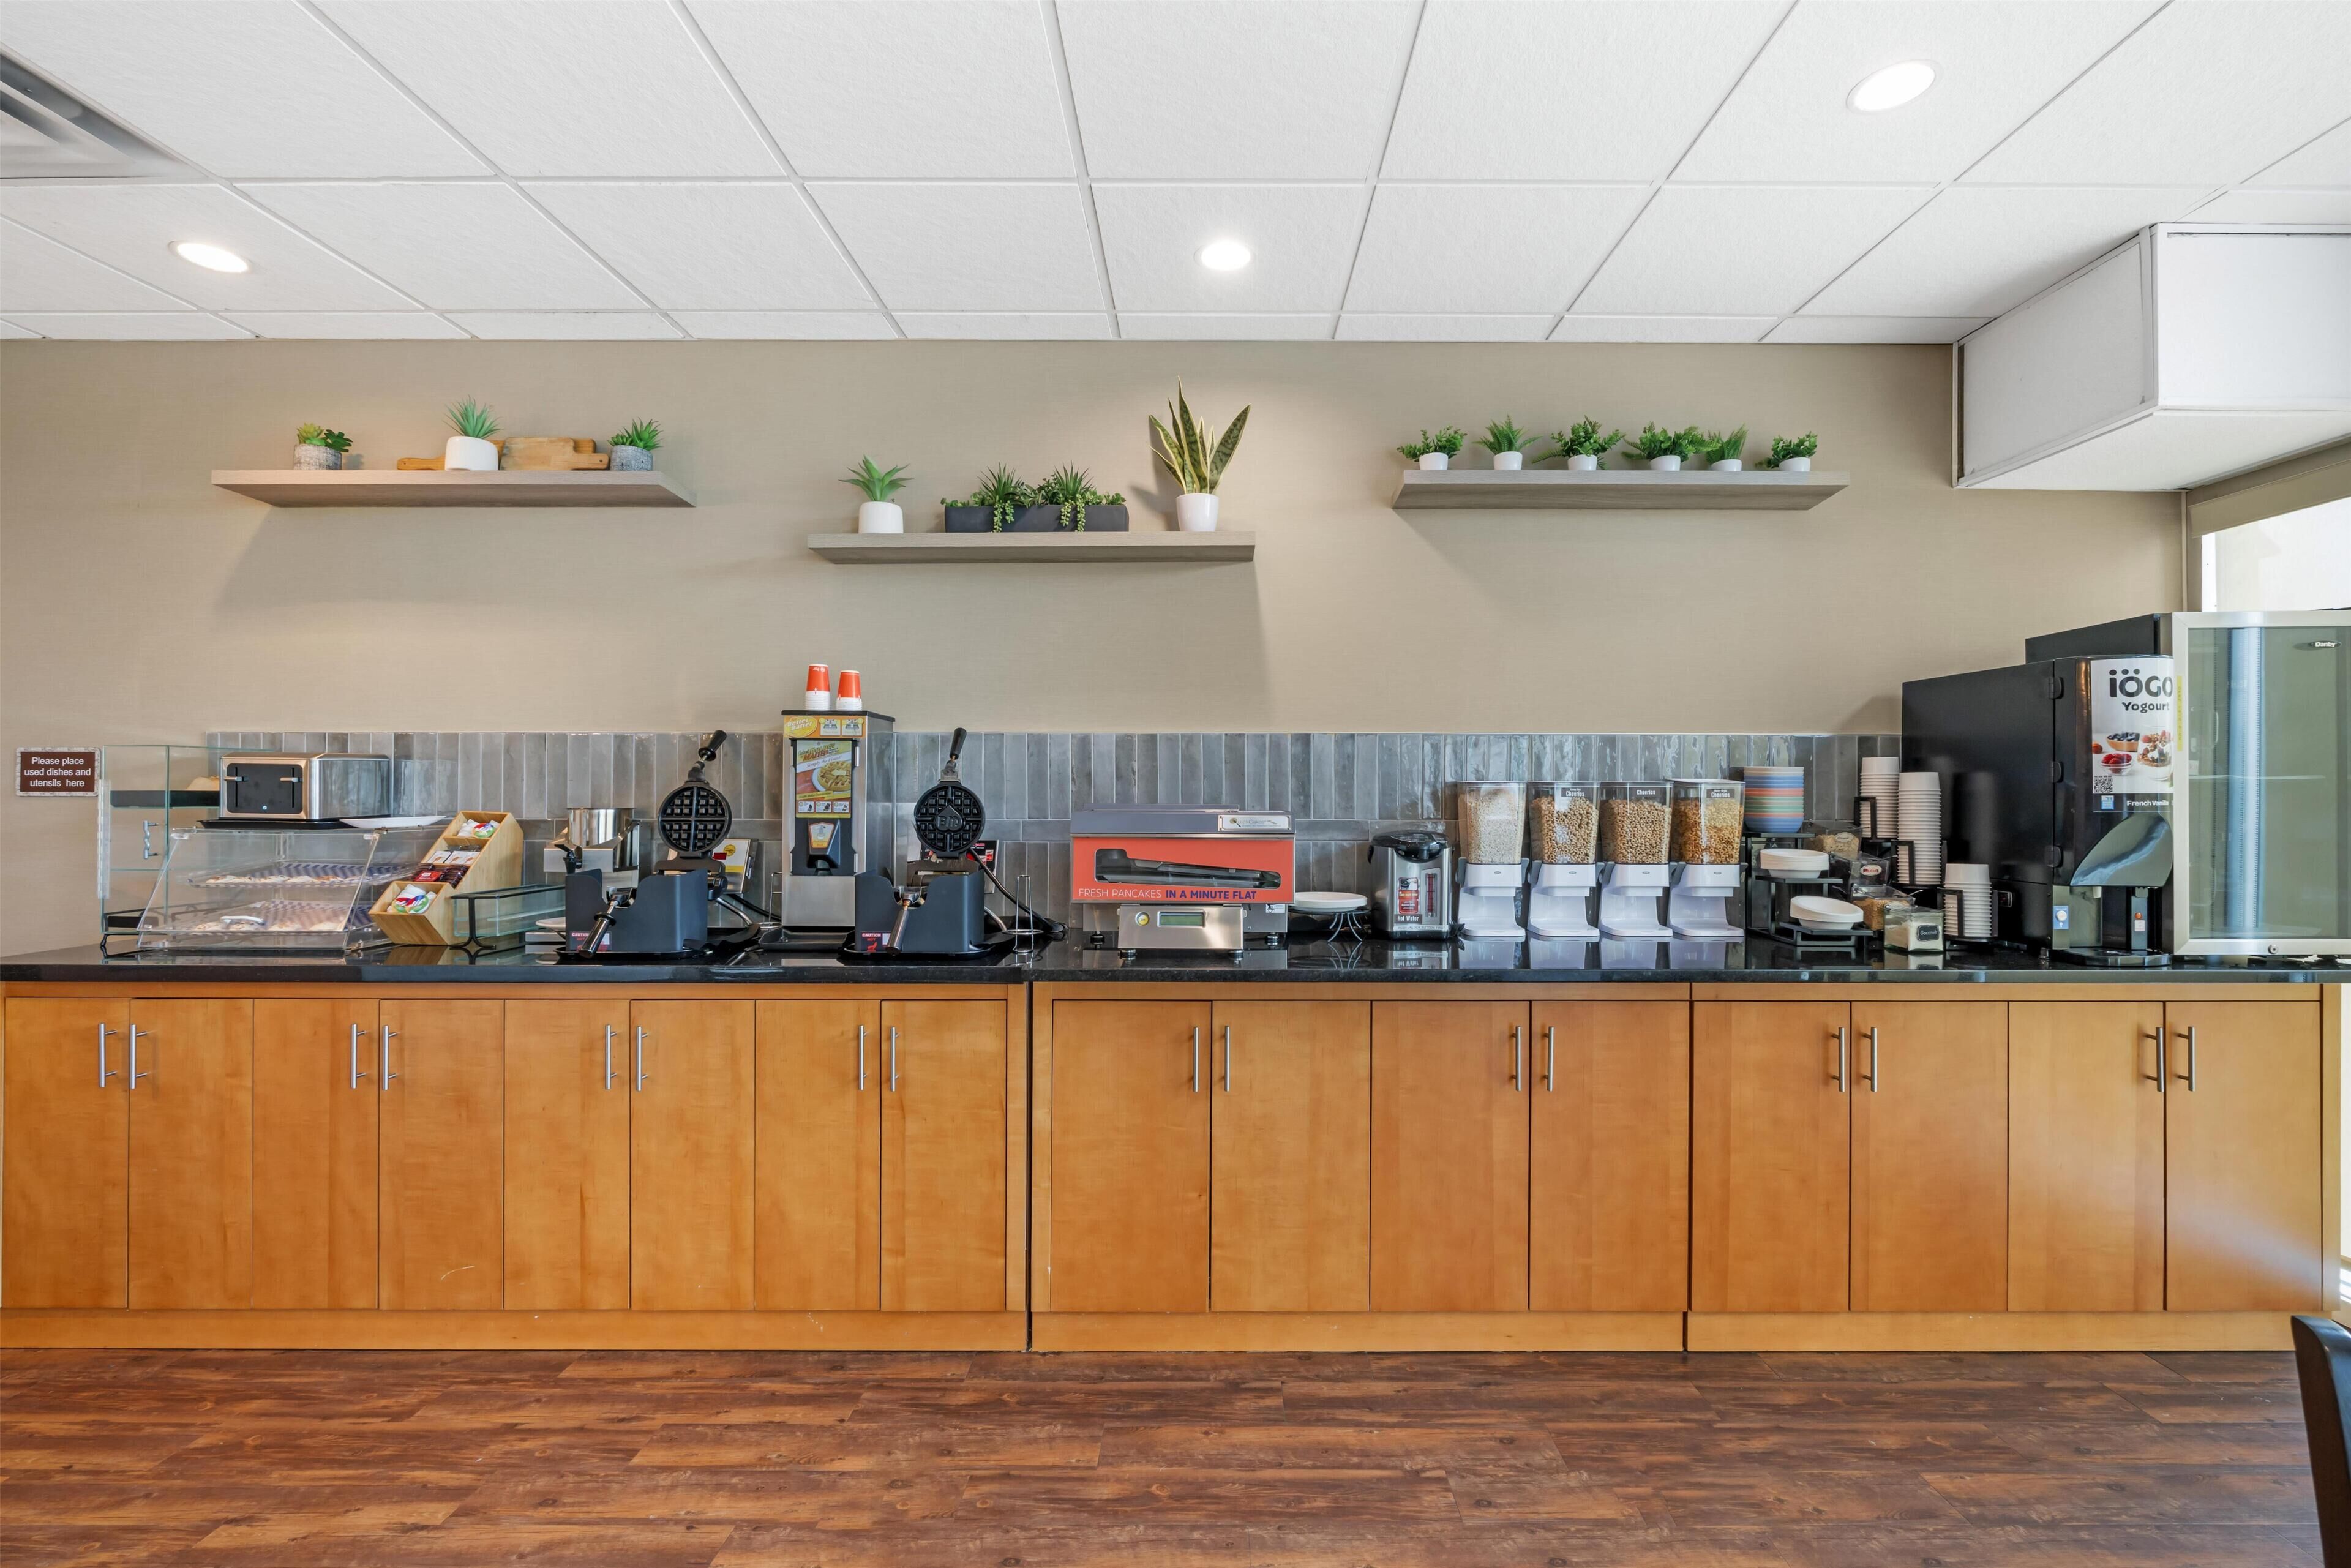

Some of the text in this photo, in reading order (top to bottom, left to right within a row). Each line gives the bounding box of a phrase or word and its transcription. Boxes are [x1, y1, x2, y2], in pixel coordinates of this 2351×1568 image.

[2121, 702, 2170, 713] Yogourt
[62, 757, 84, 766] place
[1079, 888, 1108, 897] FRESH
[1112, 889, 1161, 898] PANCAKES
[1166, 890, 1176, 898] IN
[1190, 890, 1229, 899] MINUTE
[1232, 891, 1257, 899] FLAT
